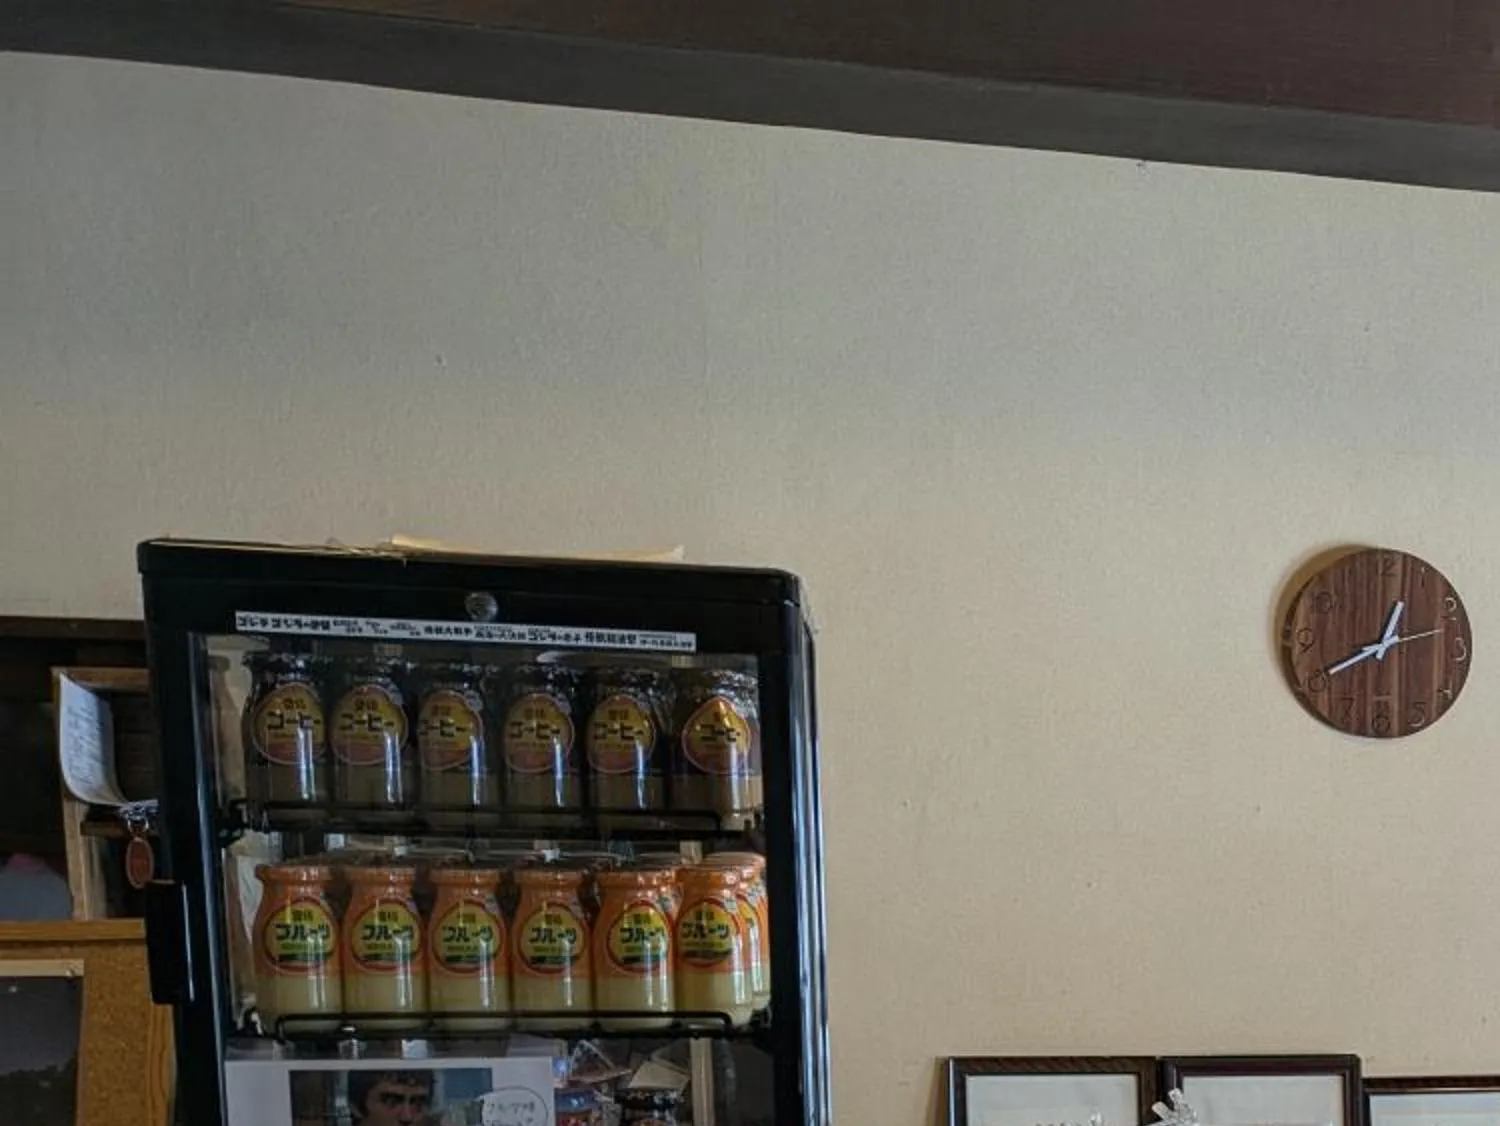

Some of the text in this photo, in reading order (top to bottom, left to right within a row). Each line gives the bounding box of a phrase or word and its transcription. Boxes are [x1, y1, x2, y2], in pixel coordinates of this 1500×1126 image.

[267, 711, 321, 731] コーヒー
[339, 713, 394, 732] コーヒー
[417, 718, 467, 738] コーヒー
[509, 720, 561, 740] コーヒー
[593, 721, 645, 741] コーヒー
[700, 722, 741, 742] コーヒー
